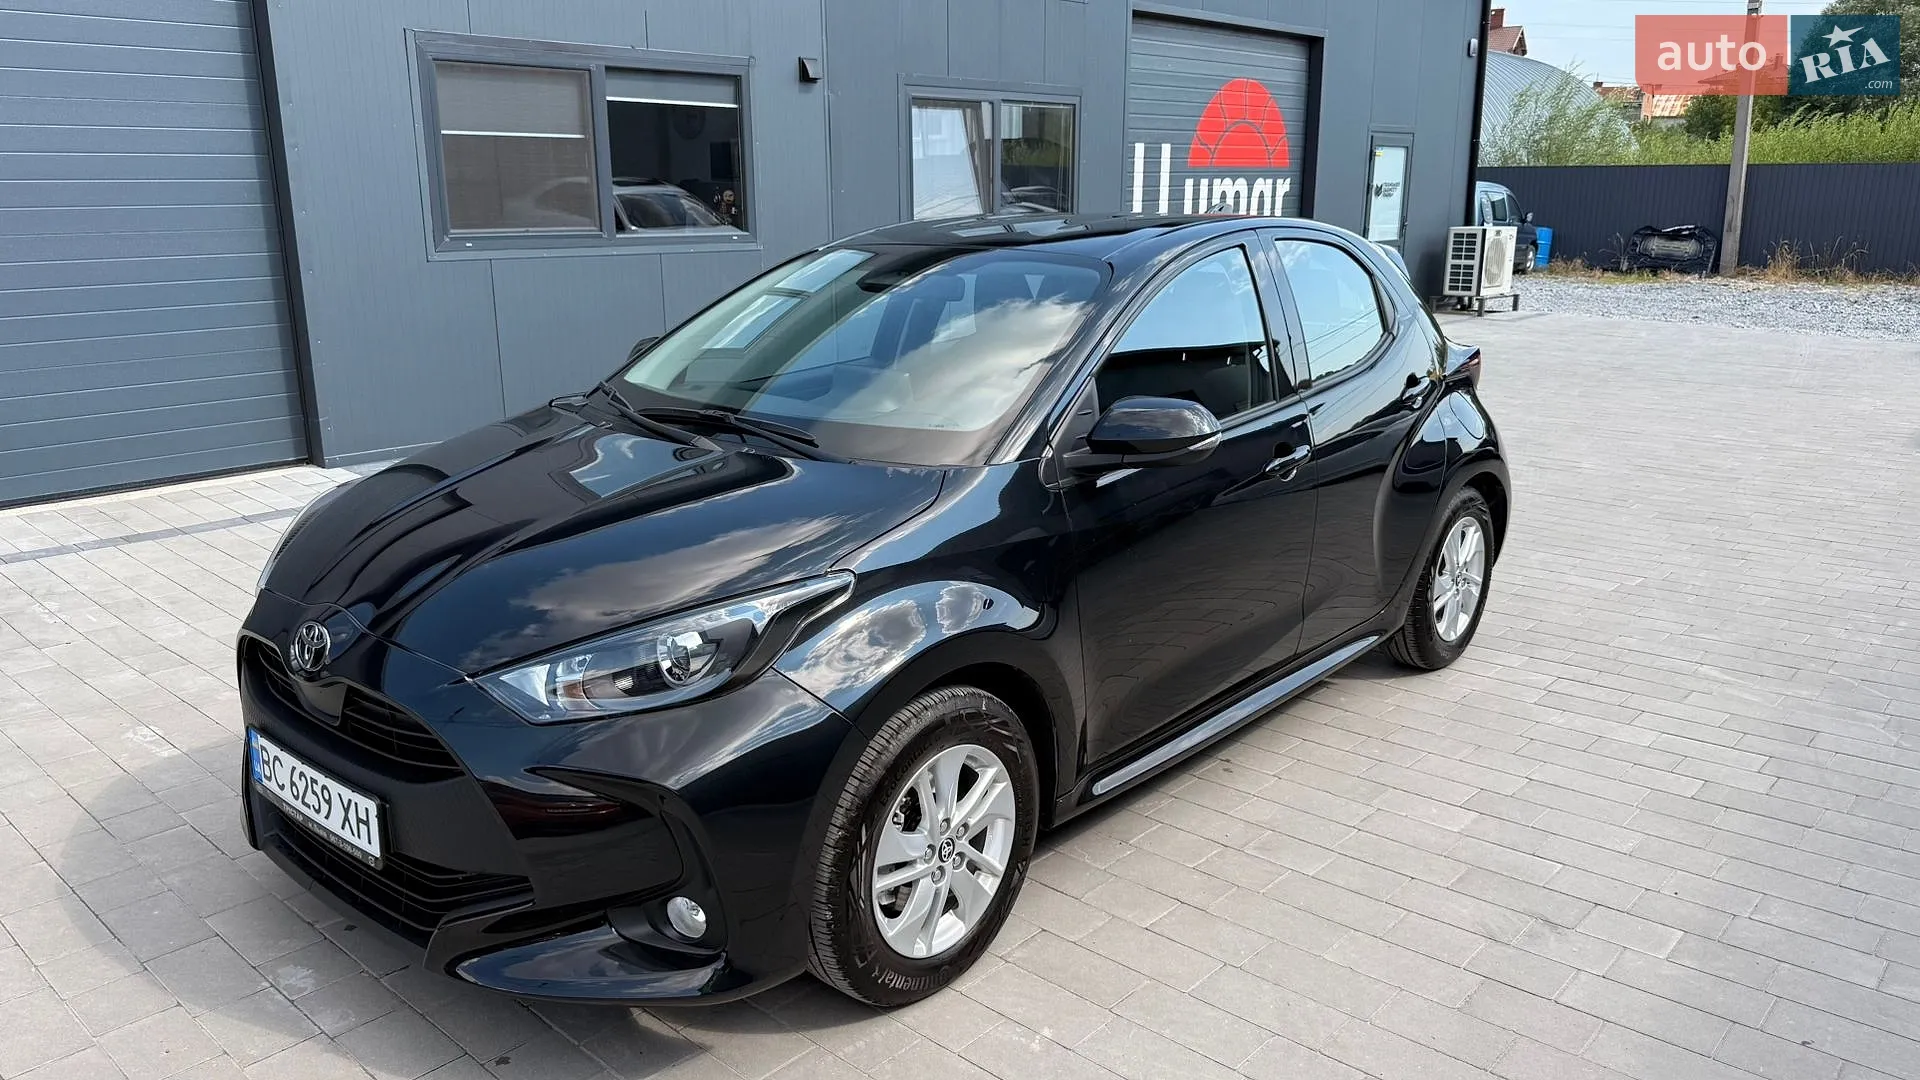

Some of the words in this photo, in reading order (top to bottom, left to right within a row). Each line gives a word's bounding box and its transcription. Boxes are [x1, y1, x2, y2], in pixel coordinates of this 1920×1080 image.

[259, 744, 286, 791] BC
[289, 766, 333, 820] 6259
[337, 792, 372, 845] XH
